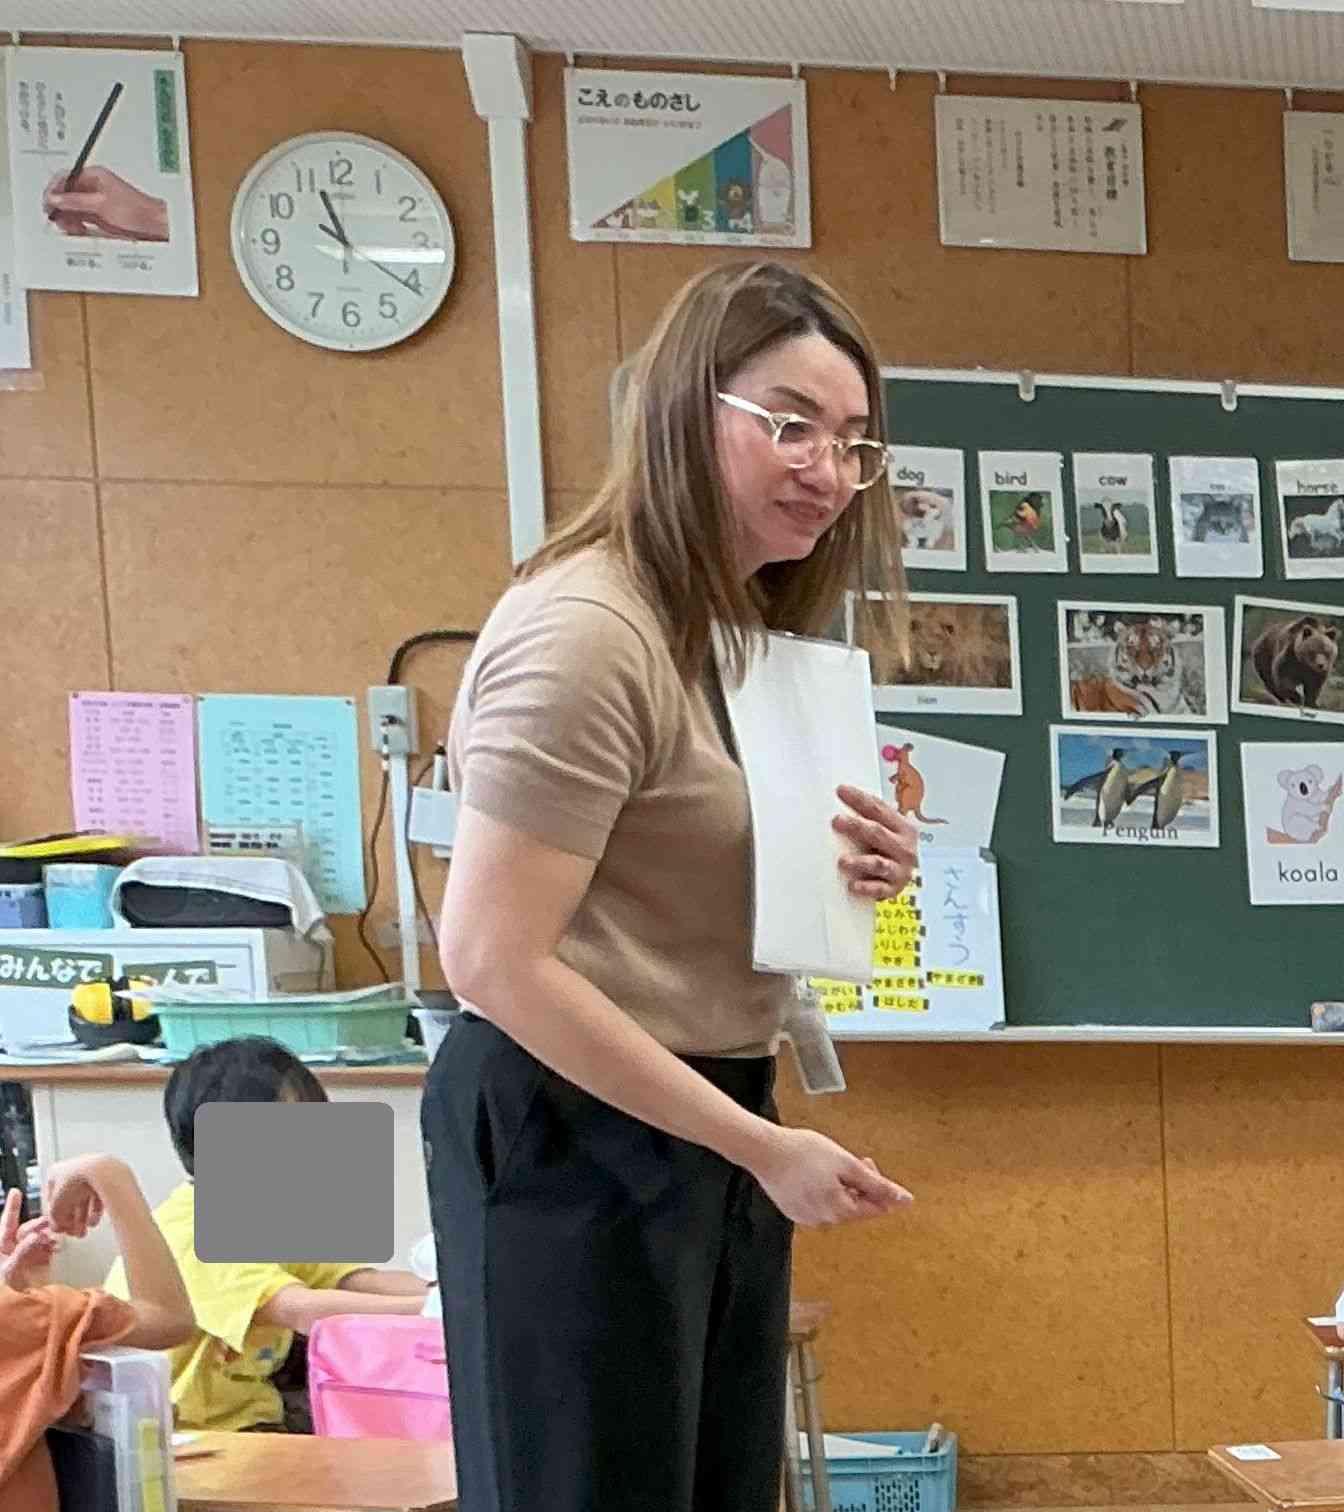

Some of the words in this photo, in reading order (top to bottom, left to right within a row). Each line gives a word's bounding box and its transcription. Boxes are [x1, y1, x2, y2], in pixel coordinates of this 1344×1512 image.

[578, 88, 701, 111] こえのものさし
[295, 165, 315, 193] 11
[328, 158, 354, 185] 12
[374, 168, 382, 195] 1
[269, 191, 295, 219] 10
[398, 195, 418, 222] 2
[260, 228, 281, 255] 9
[275, 264, 295, 291] 8
[404, 267, 424, 294] 4
[307, 291, 325, 319] 7
[341, 301, 361, 328] 6
[379, 292, 398, 319] 5
[897, 468, 925, 485] dog
[994, 472, 1027, 486] bird
[1098, 475, 1127, 486] cow
[1297, 480, 1338, 493] horse
[1103, 824, 1178, 841] Penguin
[1279, 861, 1338, 882] koala
